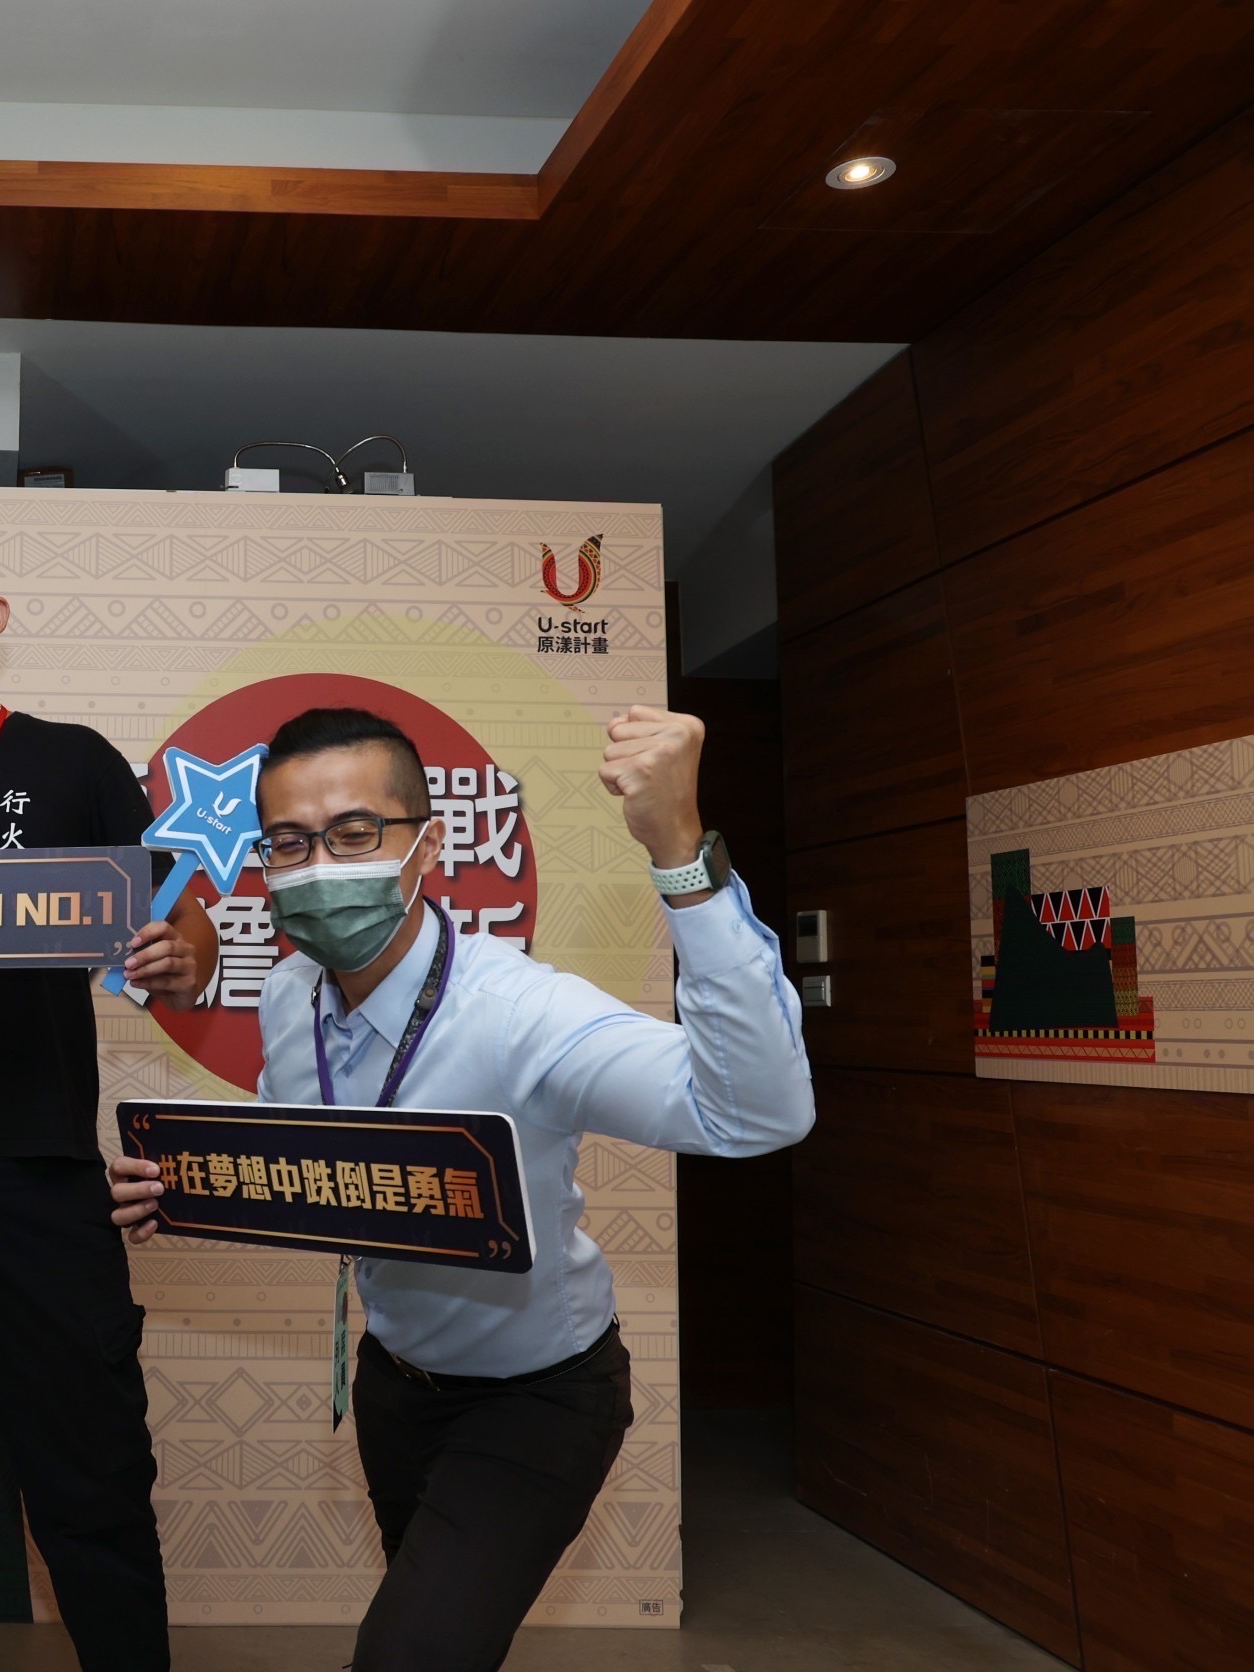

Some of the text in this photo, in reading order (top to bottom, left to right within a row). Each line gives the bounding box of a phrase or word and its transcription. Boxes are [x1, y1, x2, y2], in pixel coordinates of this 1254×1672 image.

[537, 616, 609, 634] U-start
[537, 636, 609, 654] 原漾計畫
[196, 807, 233, 835] U-start
[16, 891, 113, 926] NO.1
[158, 1151, 485, 1219] #在夢想中跌倒是勇氣
[641, 1602, 661, 1613] 廣告
